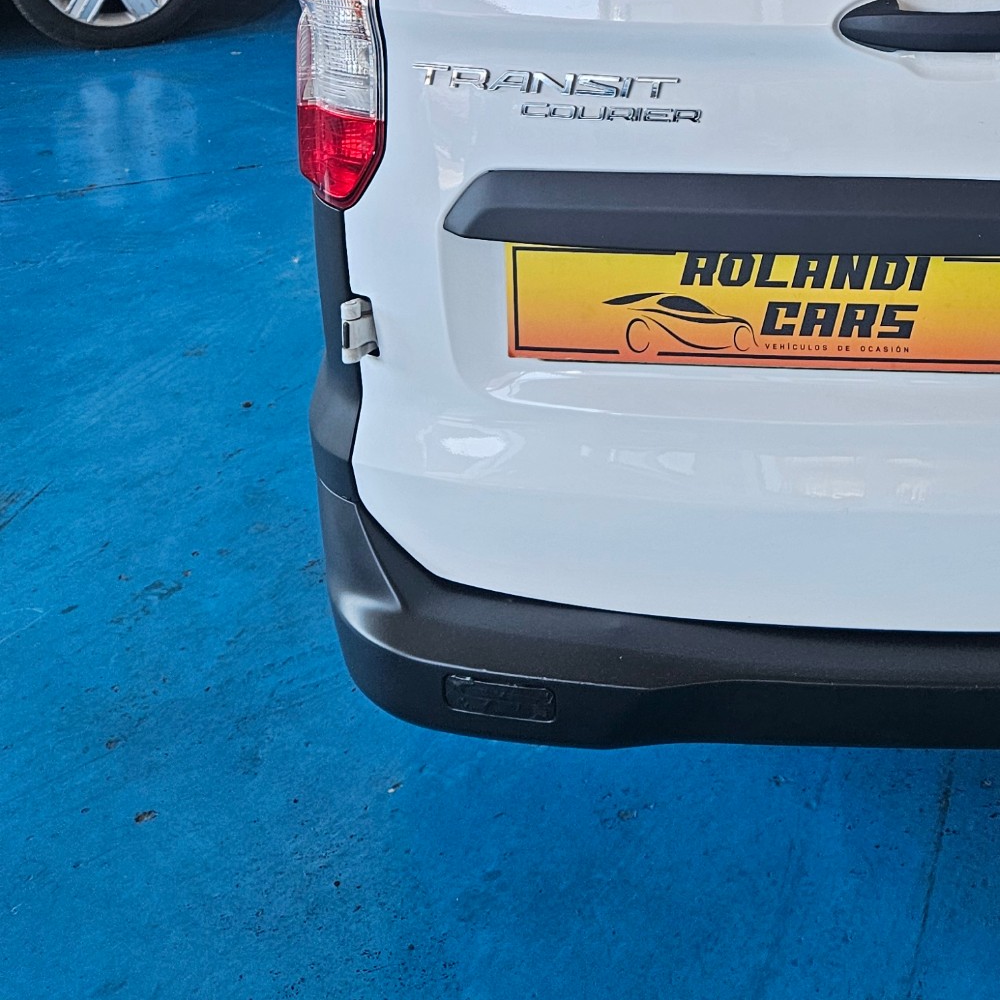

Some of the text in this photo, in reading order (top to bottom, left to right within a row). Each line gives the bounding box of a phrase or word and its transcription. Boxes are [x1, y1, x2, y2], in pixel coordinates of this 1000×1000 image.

[412, 61, 681, 99] TRANSIT
[520, 102, 703, 124] COURIER
[680, 252, 931, 291] ROLANDI
[760, 301, 920, 339] CARS
[765, 343, 828, 351] VEHÍCULOS
[860, 344, 910, 353] OCASIÓN
